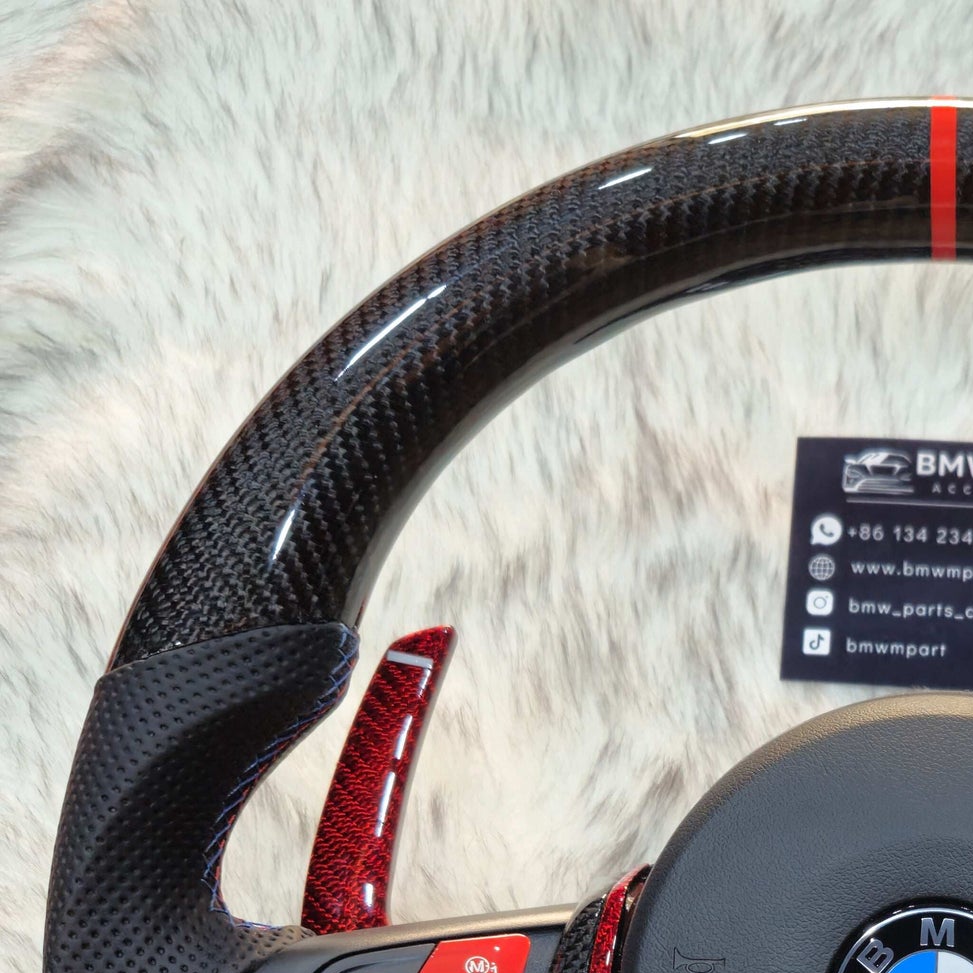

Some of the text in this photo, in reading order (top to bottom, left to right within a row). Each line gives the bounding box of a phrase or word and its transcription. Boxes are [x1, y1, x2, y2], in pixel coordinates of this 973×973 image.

[848, 523, 885, 542] +86
[893, 526, 928, 543] 134
[846, 637, 947, 658] bmwmpart
